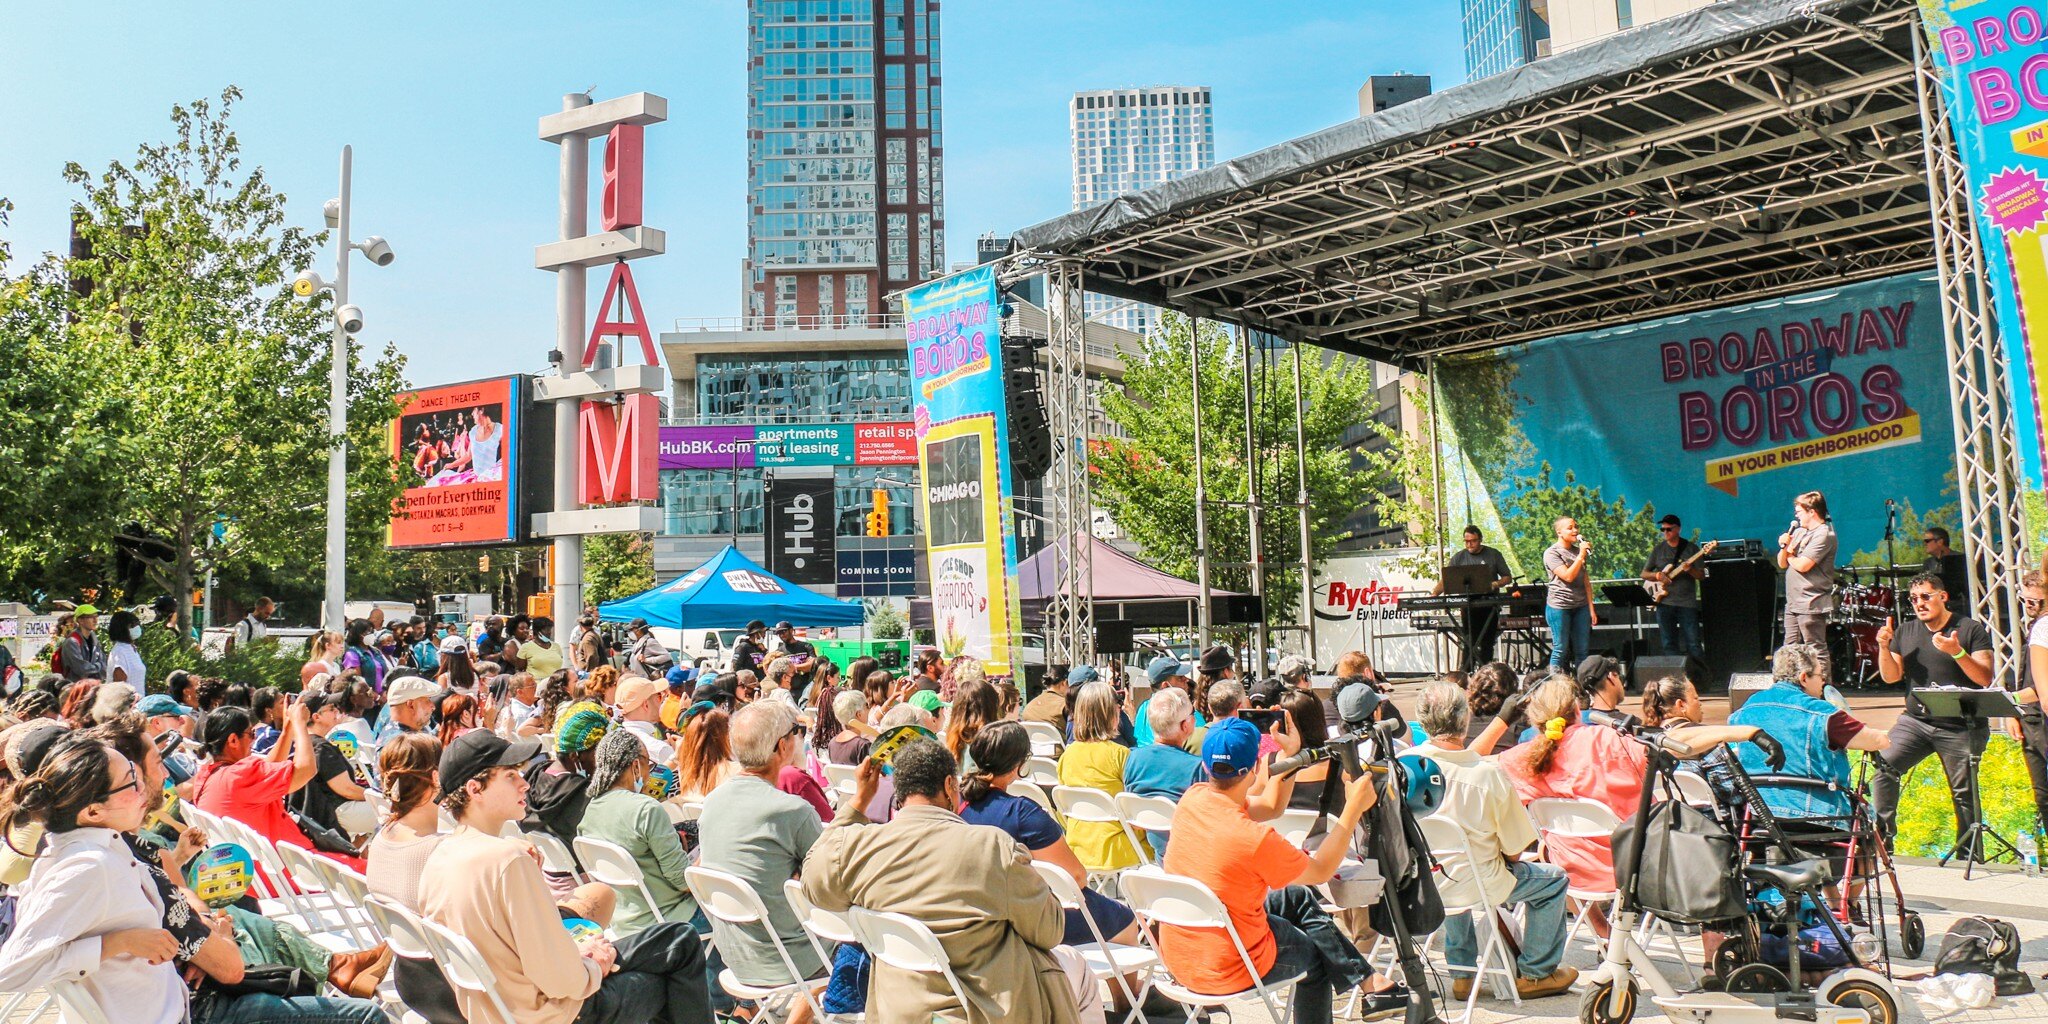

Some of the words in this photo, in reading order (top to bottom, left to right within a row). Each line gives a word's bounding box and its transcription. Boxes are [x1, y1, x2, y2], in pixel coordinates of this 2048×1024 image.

[2026, 128, 2044, 143] IN
[1991, 186, 2021, 204] FEATURING
[2020, 181, 2030, 189] HIT
[1996, 187, 2036, 212] BROADWAY
[2001, 195, 2040, 218] MUSICALS!
[907, 300, 990, 343] BROADWAY
[1660, 301, 1915, 383] BROADWAY
[914, 331, 987, 379] BOROS
[1755, 369, 1775, 388] IN
[1782, 354, 1817, 382] THE
[421, 397, 444, 408] DANCE
[450, 392, 481, 404] THEATER
[1679, 364, 1904, 451] BOROS
[758, 428, 838, 442] apartments
[858, 426, 895, 438] retail
[659, 441, 751, 455] HubBK.com
[790, 442, 839, 456] leasing
[1718, 462, 1734, 477] IN
[1737, 454, 1777, 473] YOUR
[1780, 424, 1904, 464] NEIGHBORHOOD
[400, 495, 426, 510] pen
[426, 492, 442, 506] for
[443, 487, 502, 505] Everything
[930, 480, 980, 504] CHICAGO
[461, 505, 496, 517] DORKYPARK
[432, 523, 445, 533] OCT
[784, 493, 815, 554] Hub
[726, 573, 749, 582] DWN
[840, 567, 879, 575] COMING
[883, 566, 913, 574] SOON
[954, 558, 974, 578] SHOP
[731, 582, 755, 590] TWN
[1328, 581, 1402, 611] Ryder
[937, 582, 974, 618] HORRORS
